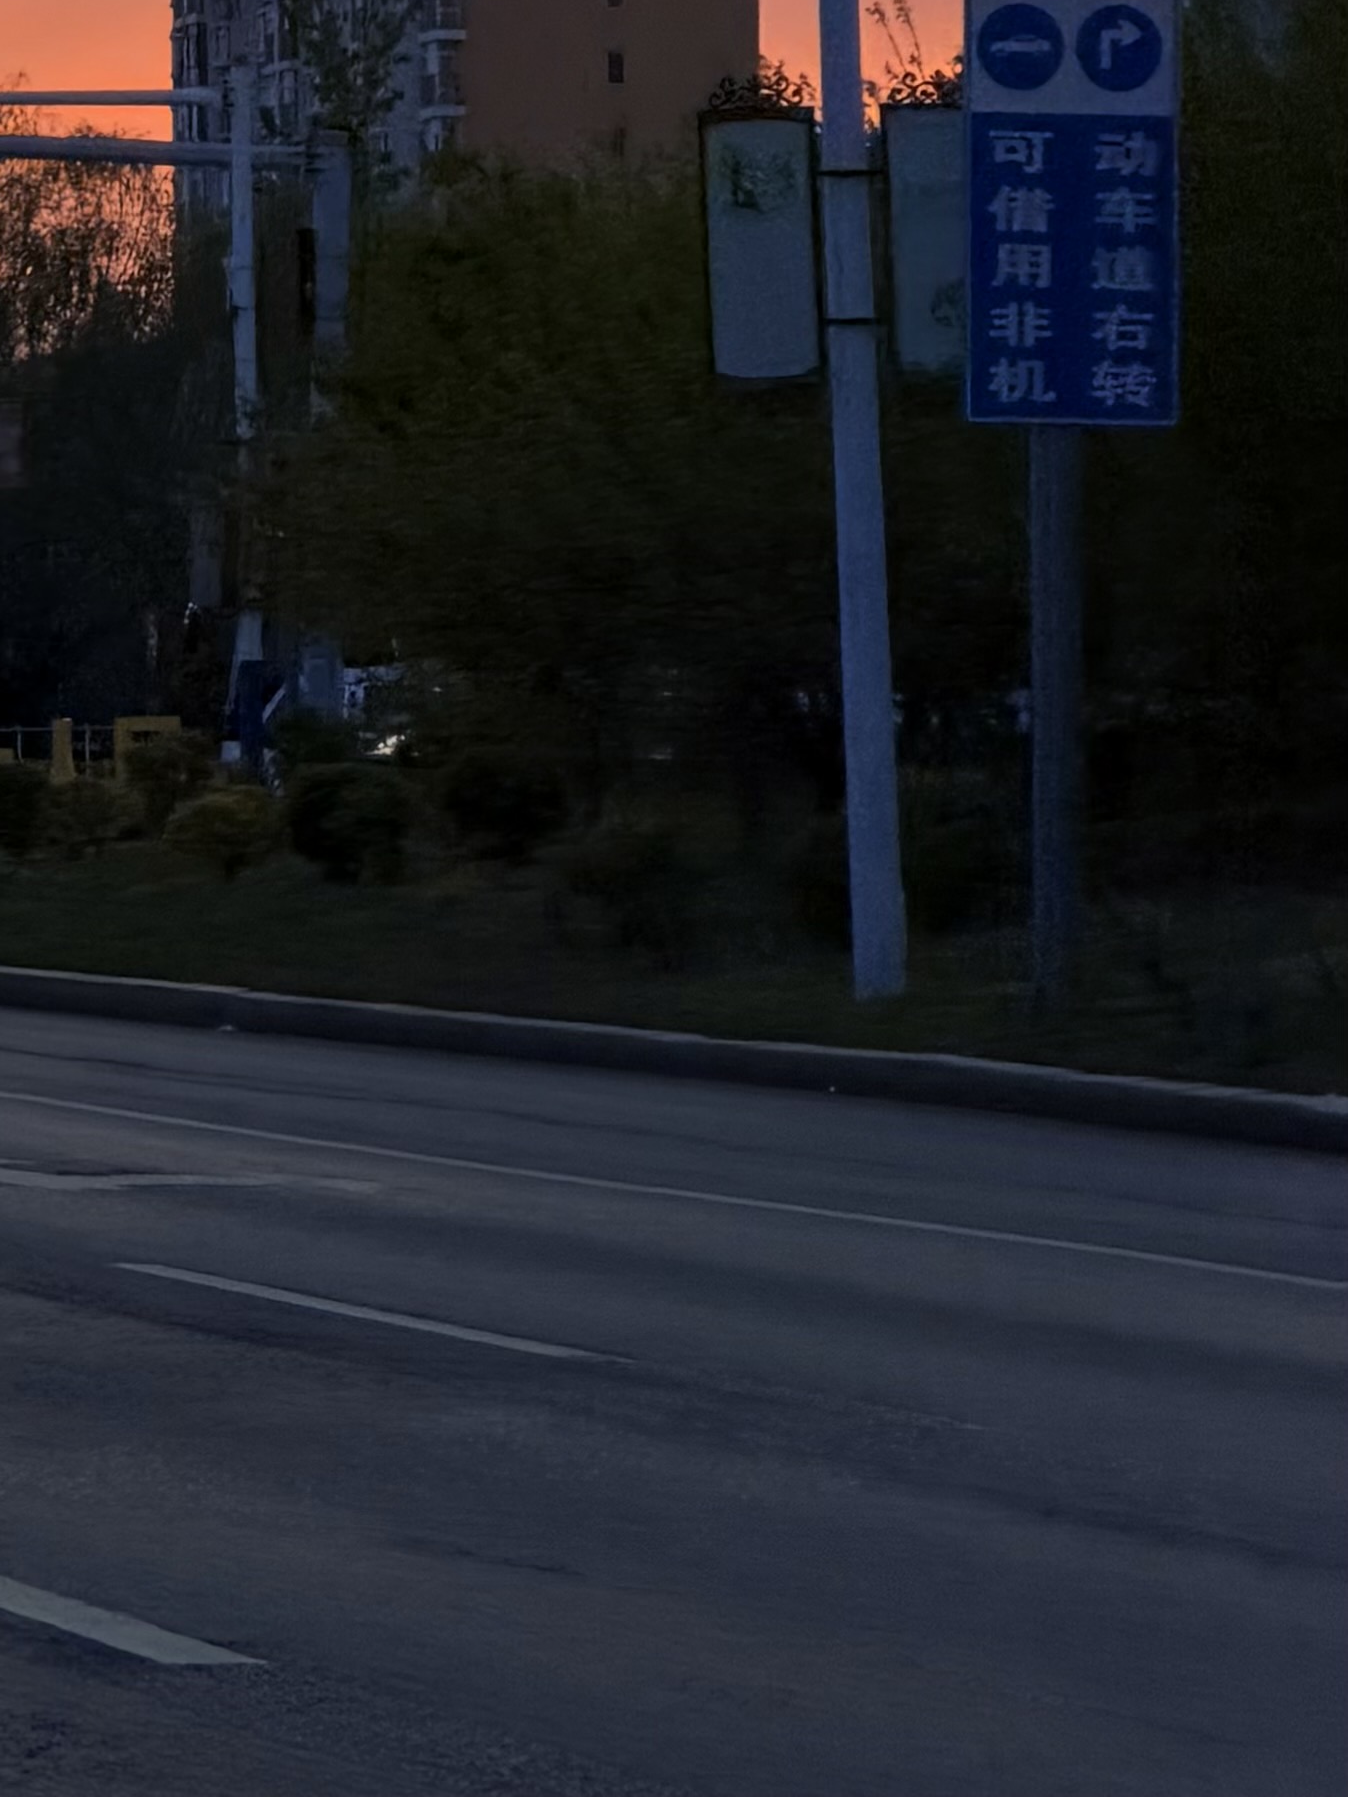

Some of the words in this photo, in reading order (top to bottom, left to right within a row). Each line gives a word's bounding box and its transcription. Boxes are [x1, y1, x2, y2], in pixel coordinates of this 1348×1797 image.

[987, 130, 1057, 404] 可借用非机
[1090, 131, 1162, 407] 动车道右转
